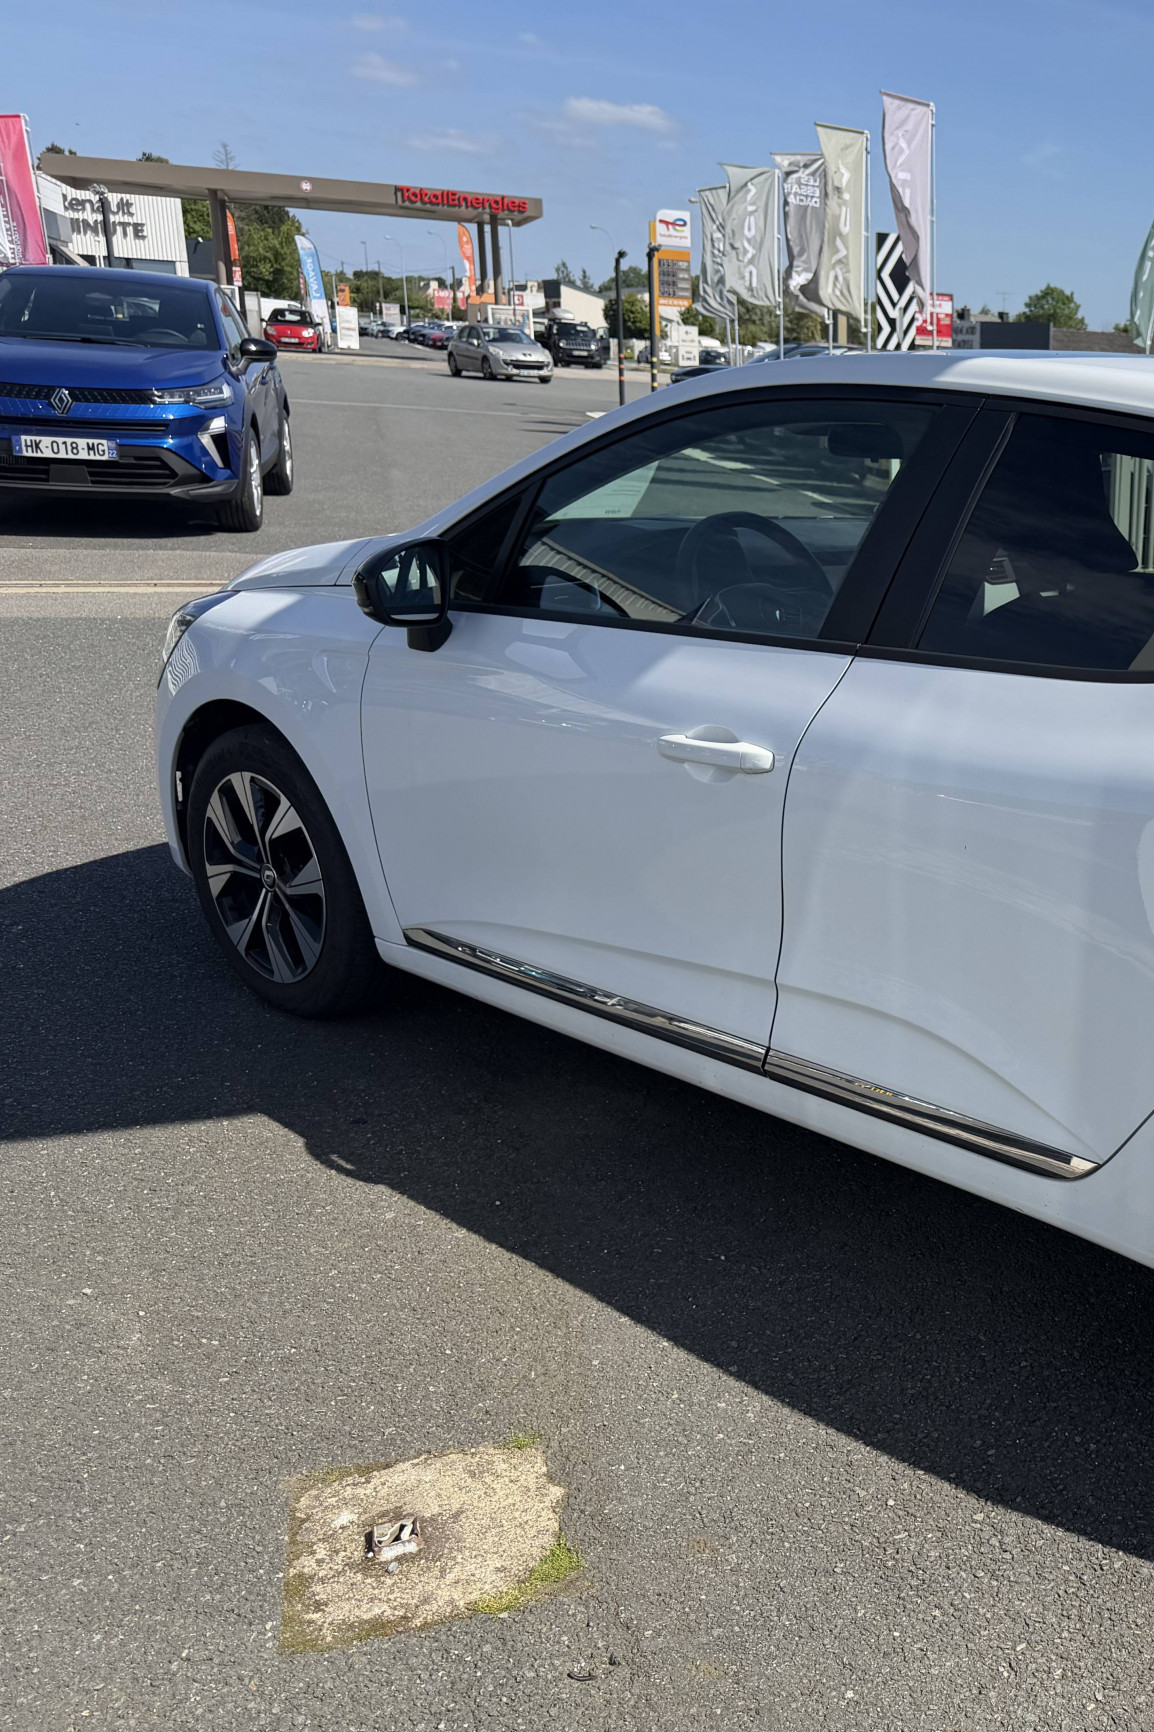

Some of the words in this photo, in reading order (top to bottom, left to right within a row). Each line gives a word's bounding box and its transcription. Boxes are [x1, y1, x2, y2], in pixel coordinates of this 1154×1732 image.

[397, 185, 529, 214] TotalEnergies
[24, 438, 106, 457] HK-018-MG
[108, 449, 118, 458] 22
